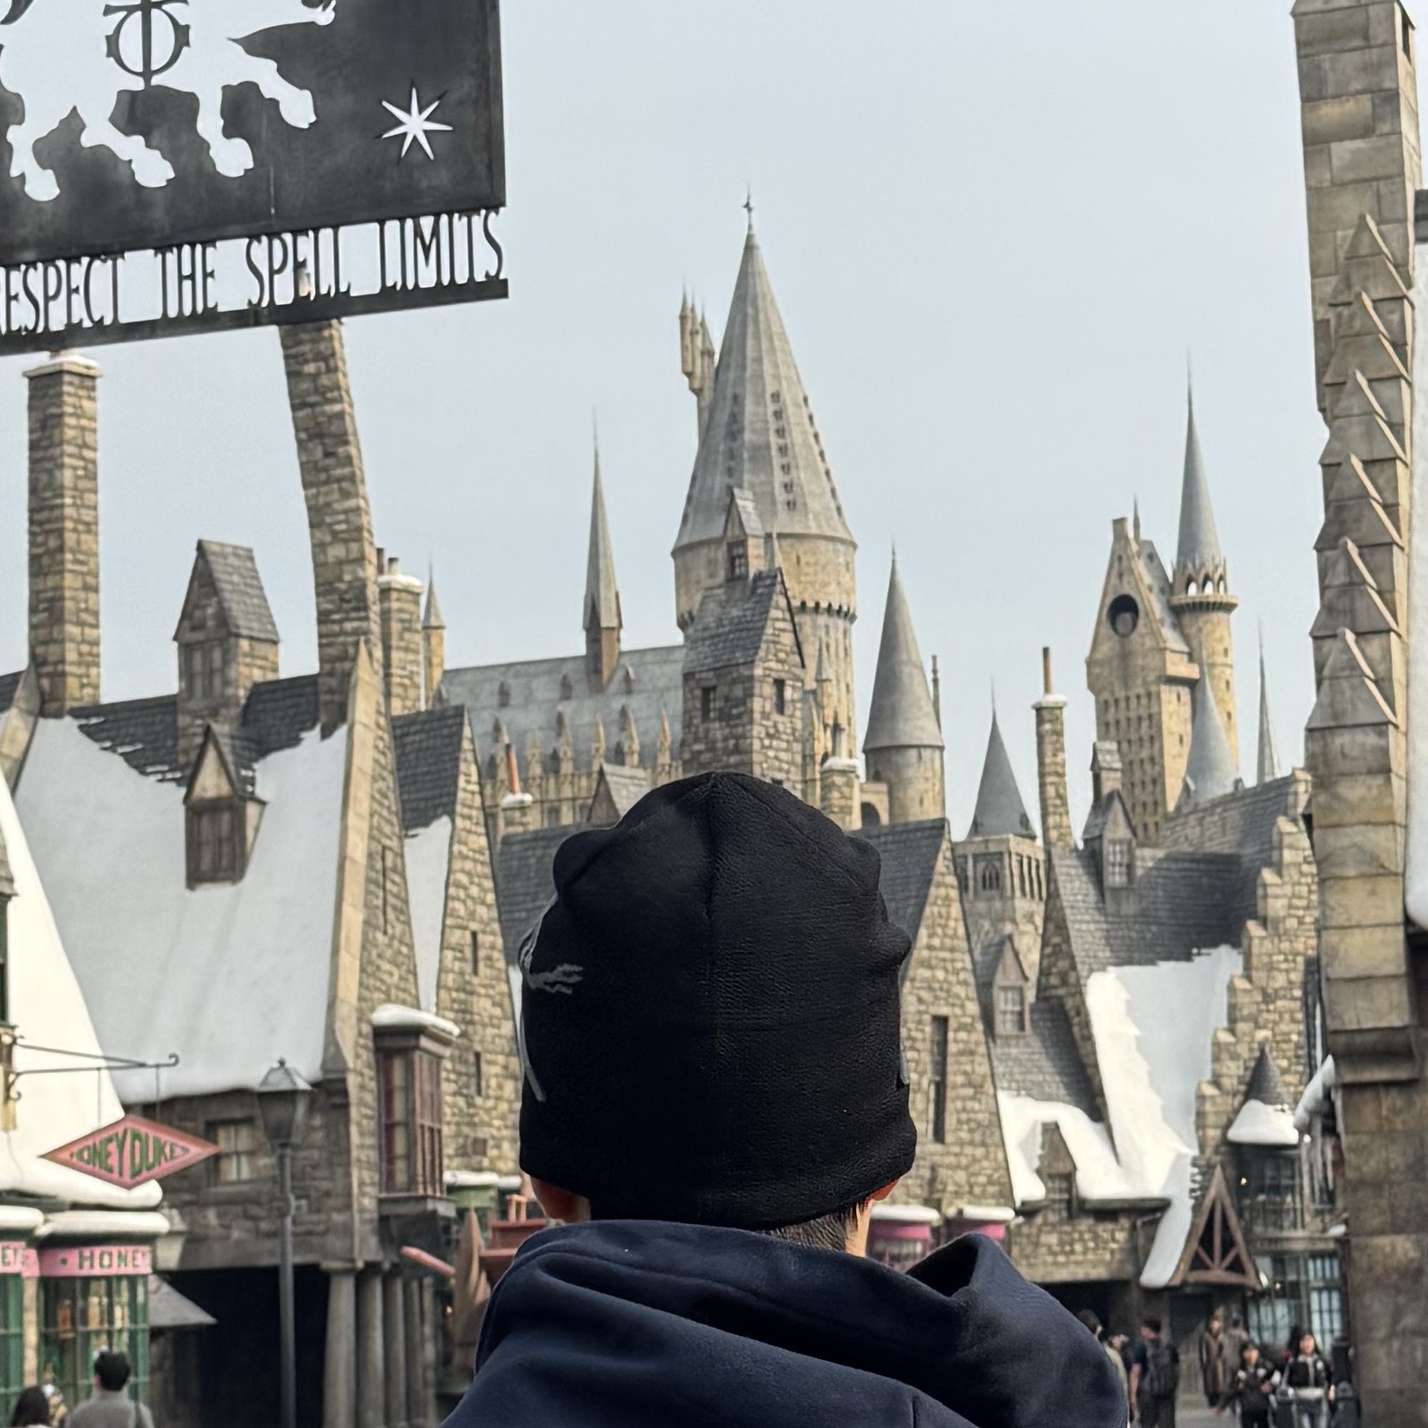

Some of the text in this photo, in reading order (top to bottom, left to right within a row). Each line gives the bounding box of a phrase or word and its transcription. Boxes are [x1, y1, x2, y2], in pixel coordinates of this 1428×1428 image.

[153, 239, 219, 320] THE
[245, 227, 352, 310] SPELL
[377, 208, 506, 289] LIMITS
